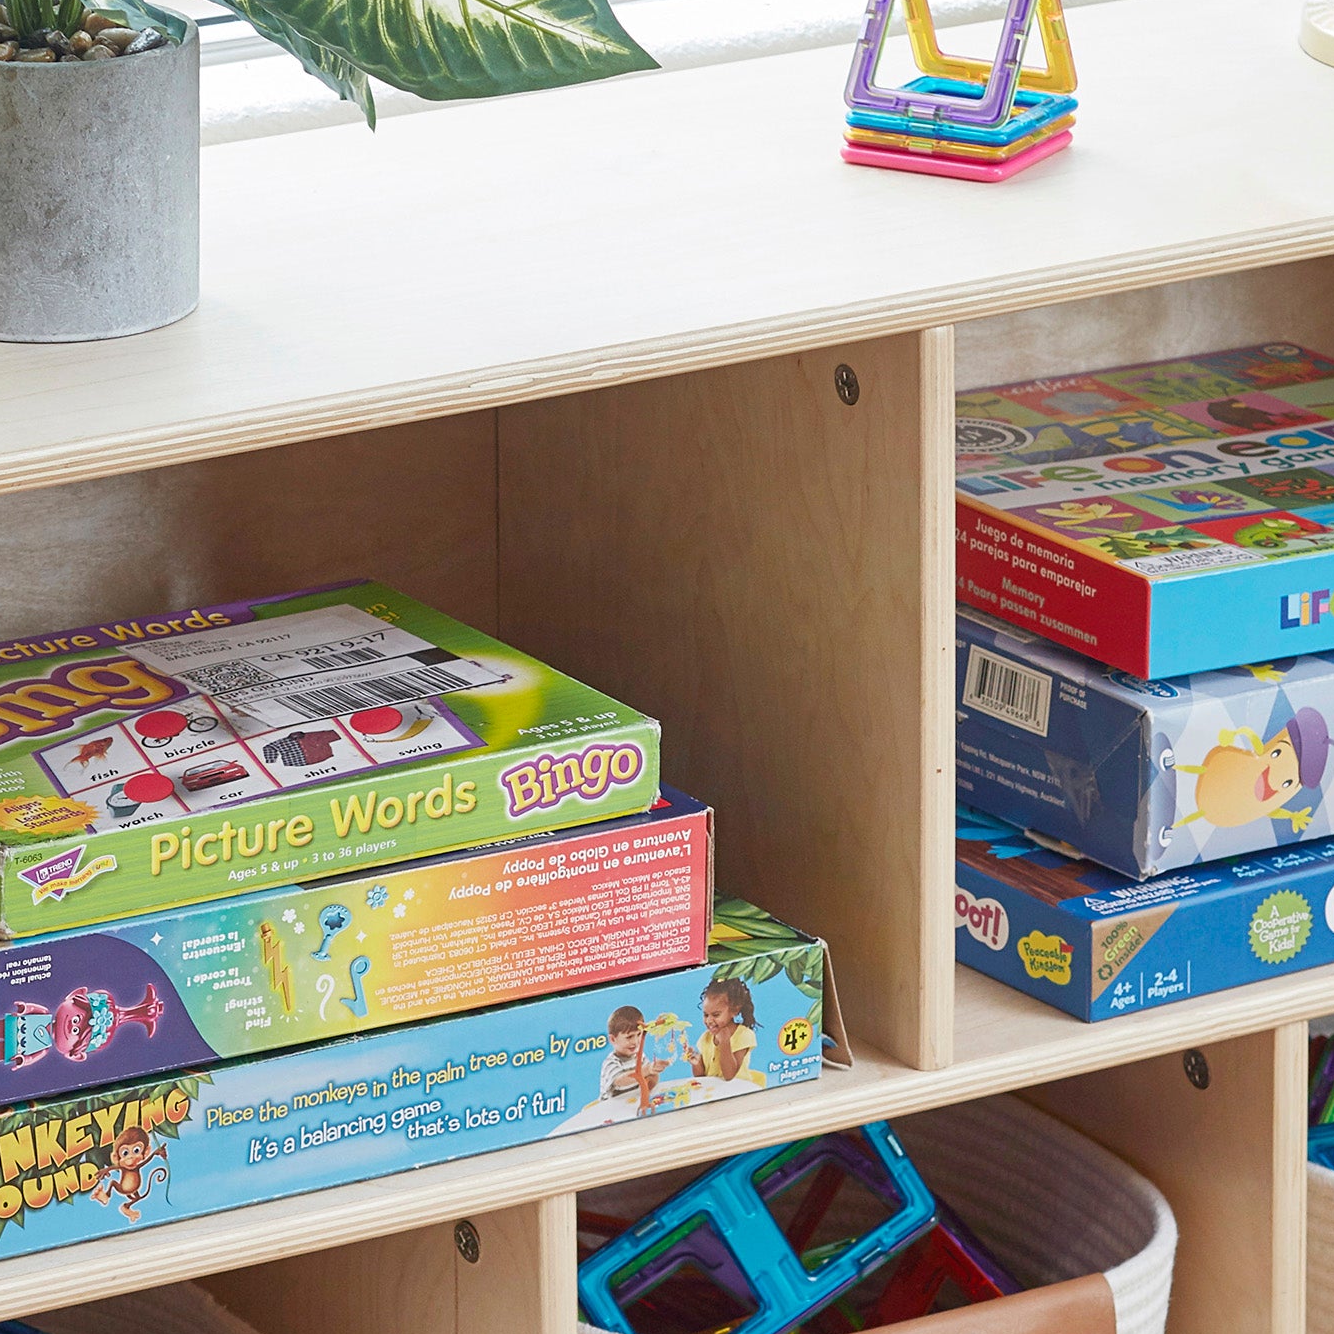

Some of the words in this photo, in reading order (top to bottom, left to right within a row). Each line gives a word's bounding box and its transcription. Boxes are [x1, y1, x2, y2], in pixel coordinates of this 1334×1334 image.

[1103, 449, 1223, 474] on
[1093, 462, 1248, 490] memory
[975, 518, 1007, 542] Juego
[1010, 532, 1024, 549] de
[1026, 542, 1075, 570] memoria
[969, 537, 1010, 562] parejas
[1012, 555, 1038, 573] para
[1040, 567, 1097, 598] emparejar
[1002, 577, 1046, 608] Memory
[967, 577, 997, 603] Paare
[1000, 597, 1037, 620] passen
[1040, 614, 1098, 646] zusammen
[99, 609, 232, 642] Words
[261, 654, 293, 663] CA
[219, 689, 250, 701] UPS
[251, 676, 315, 693] GROUND
[517, 722, 559, 736] Ages
[563, 719, 575, 730] 5
[576, 714, 593, 725] &
[595, 710, 617, 723] up
[164, 739, 216, 759] bicycle
[398, 742, 442, 757] swing
[90, 769, 119, 782] fish
[304, 766, 338, 779] shirt
[505, 748, 639, 813] Bingo
[219, 790, 244, 801] car
[4, 799, 42, 814] Aligns
[15, 805, 74, 824] Learning
[19, 806, 47, 817] with
[23, 809, 85, 829] Standards
[118, 811, 164, 830] watch
[151, 813, 313, 876] Picture
[330, 773, 478, 838] Words
[612, 841, 629, 853] en
[633, 828, 691, 851] Aventura
[14, 852, 43, 865] T-6063
[311, 853, 319, 865] 3
[322, 851, 335, 864] to
[338, 847, 352, 860] 36
[355, 839, 398, 857] players
[549, 853, 565, 868] de
[569, 844, 608, 864] Globo
[623, 842, 691, 867] L'aventure
[48, 858, 73, 873] TREND
[228, 864, 258, 882] Ages
[260, 862, 269, 875] 5
[271, 861, 282, 873] &
[284, 860, 299, 874] up
[503, 855, 543, 877] Poppy
[602, 857, 619, 870] en
[663, 865, 690, 877] Estado
[516, 859, 598, 889] montgolfière
[652, 870, 662, 880] de
[448, 880, 490, 902] Poppy
[495, 879, 511, 893] de
[1270, 905, 1280, 917] A
[1253, 911, 1309, 933] Cooperative
[182, 934, 226, 952] cuerda!
[227, 931, 238, 941] la
[1101, 920, 1128, 949] 100%
[1259, 928, 1289, 944] Game
[1290, 923, 1301, 935] for
[182, 938, 246, 961] ¡Encuentra
[1025, 941, 1068, 963] Peaceable
[1103, 926, 1139, 962] Green
[1114, 934, 1145, 968] Inside!
[1269, 936, 1296, 955] Kids!
[228, 967, 239, 977] la
[1029, 958, 1066, 974] Kingdom
[212, 975, 252, 991] Trouve
[1154, 968, 1178, 986] 2-4
[1113, 982, 1133, 996] 4+
[1147, 982, 1185, 999] Players
[225, 995, 263, 1013] string!
[246, 1006, 266, 1018] the
[1110, 994, 1136, 1010] Ages
[245, 1016, 272, 1030] Find
[784, 1029, 808, 1051] 4+
[206, 1107, 254, 1130] Place
[258, 1102, 288, 1123] the
[293, 1082, 369, 1110] monkeys
[372, 1080, 388, 1098] in
[391, 1068, 422, 1090] the
[426, 1062, 466, 1094] palm
[469, 1052, 508, 1072] tree
[512, 1047, 545, 1066] one
[549, 1035, 570, 1059] by
[575, 1034, 607, 1053] one
[407, 1116, 461, 1141] that's
[465, 1108, 500, 1130] lots
[504, 1095, 528, 1121] of
[532, 1089, 566, 1116] fun!
[248, 1135, 278, 1164] It's
[283, 1136, 296, 1153] a
[300, 1113, 387, 1151] balancing
[391, 1099, 442, 1130] game
